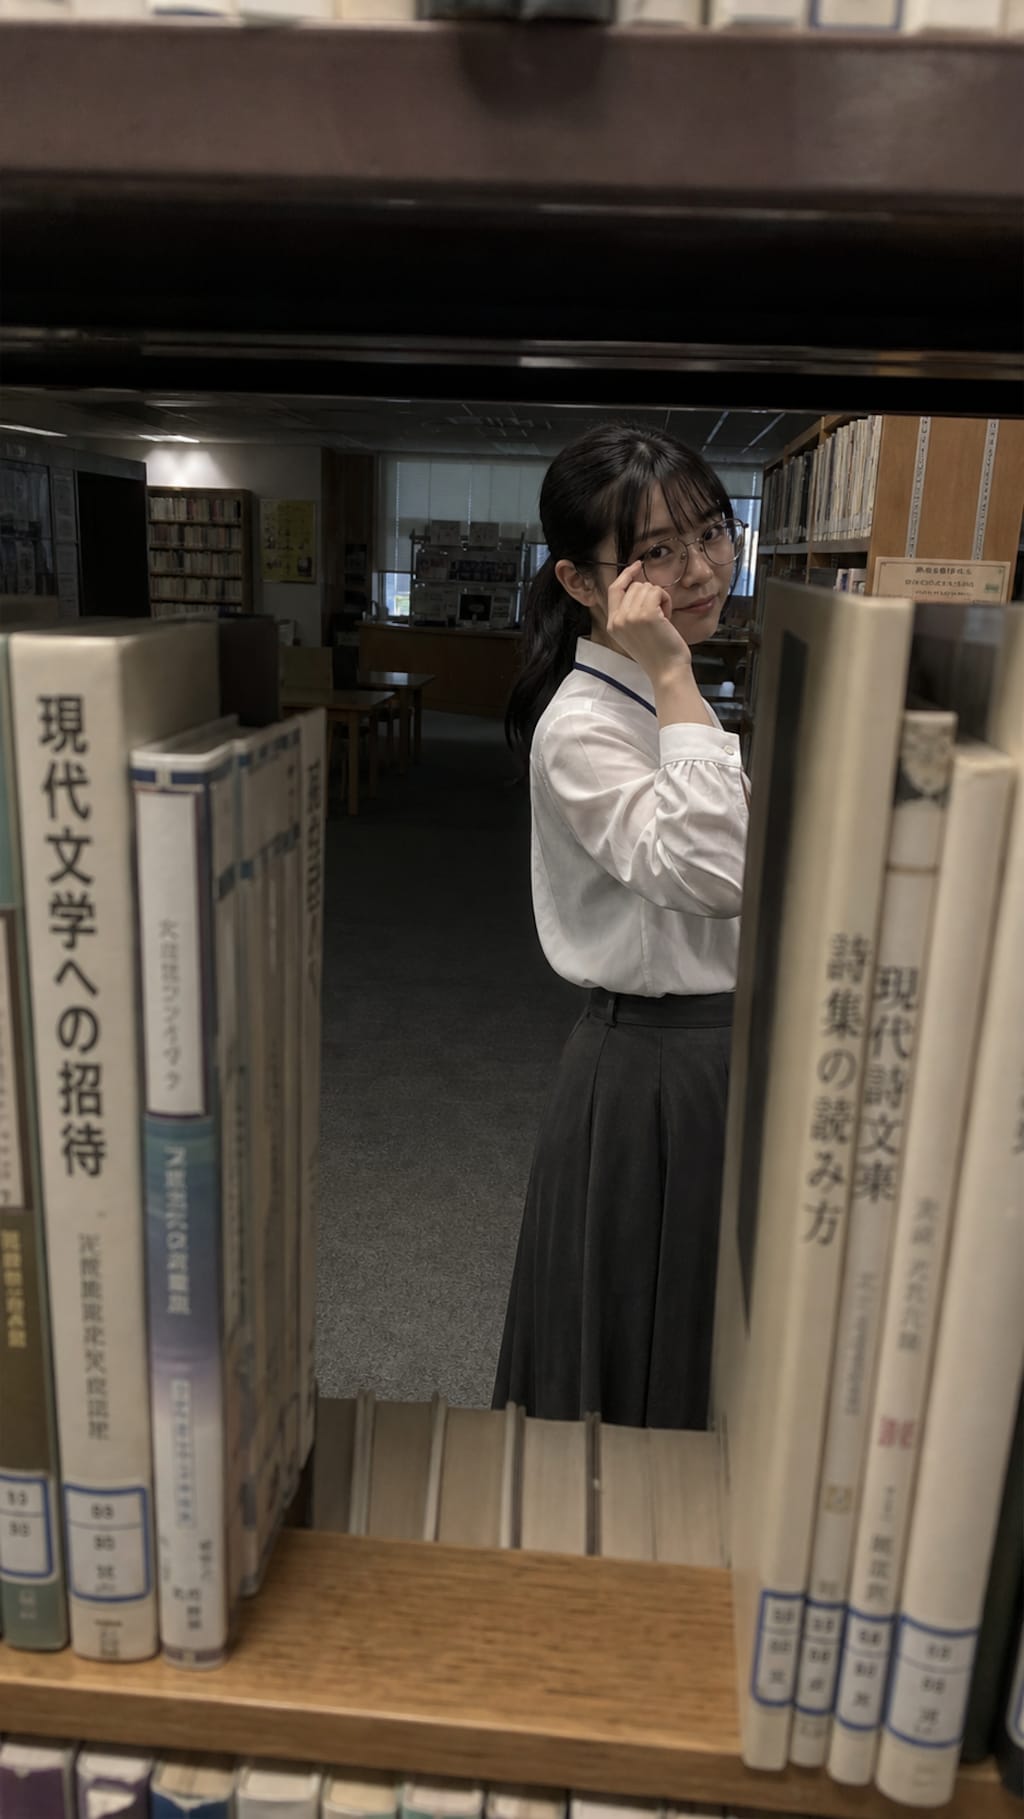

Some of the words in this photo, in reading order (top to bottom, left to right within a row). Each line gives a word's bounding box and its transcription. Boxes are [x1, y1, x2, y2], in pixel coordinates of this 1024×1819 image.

[37, 693, 106, 1178] 現代文学への招待
[803, 931, 871, 1247] 詩集の読み方
